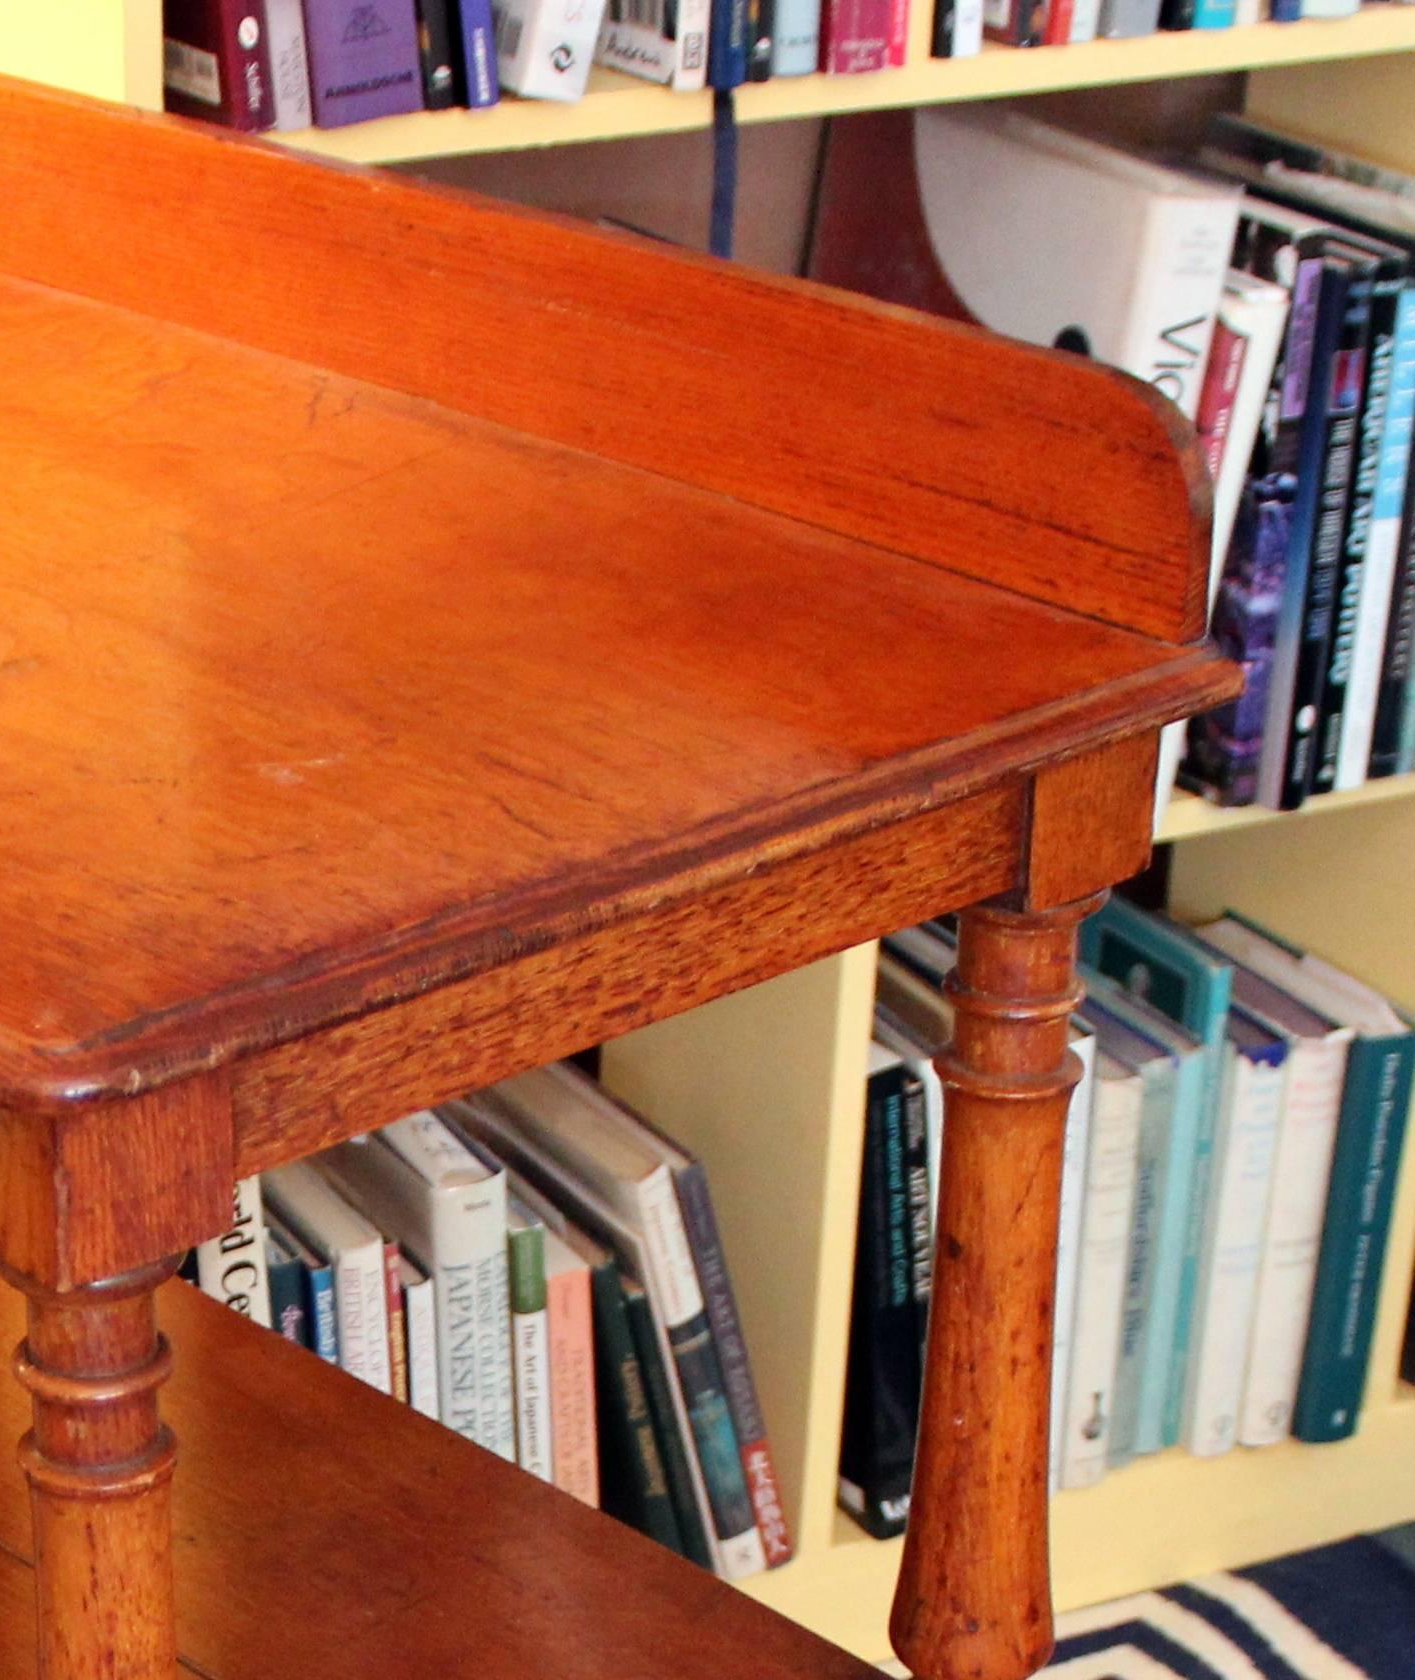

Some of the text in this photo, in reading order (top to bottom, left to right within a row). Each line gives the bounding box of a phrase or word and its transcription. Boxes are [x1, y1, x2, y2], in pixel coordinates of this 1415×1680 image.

[222, 1260, 257, 1317] Ce
[442, 1263, 475, 1400] JAPANESE
[523, 1323, 538, 1347] The
[524, 1355, 538, 1374] Art
[526, 1379, 539, 1391] of
[522, 1392, 540, 1458] Japanese
